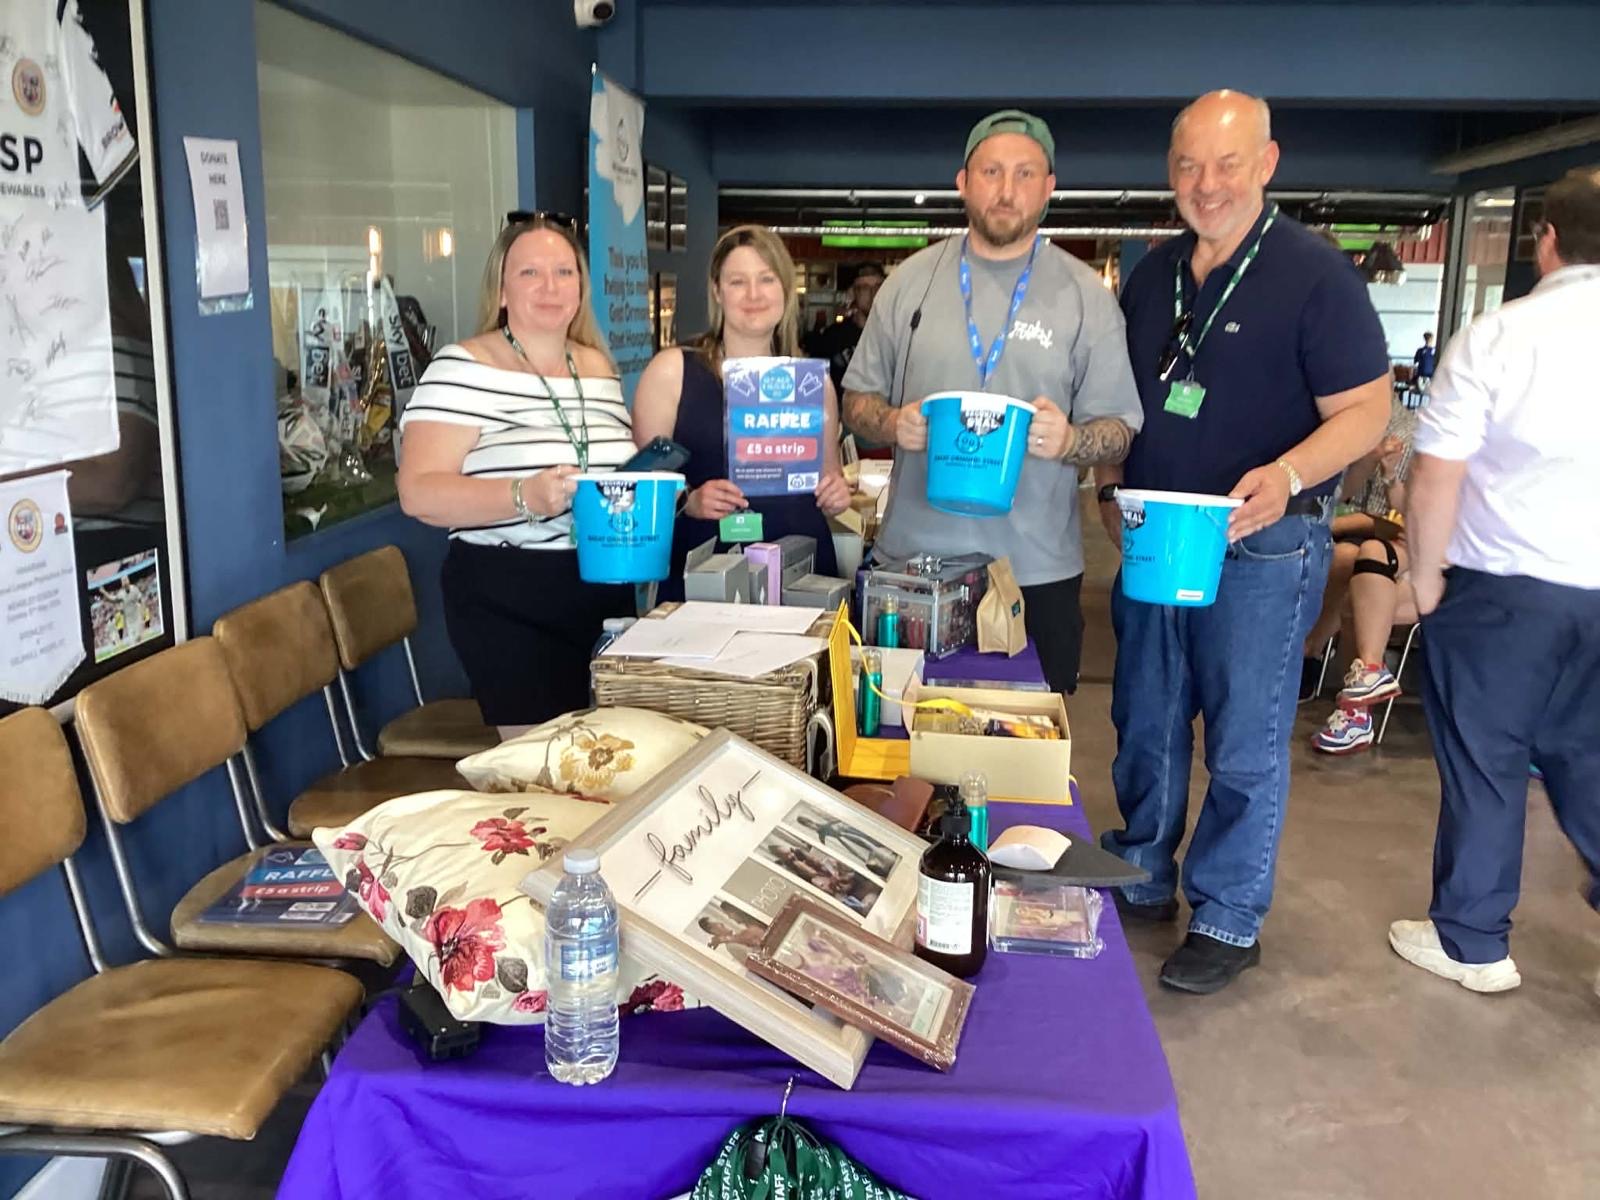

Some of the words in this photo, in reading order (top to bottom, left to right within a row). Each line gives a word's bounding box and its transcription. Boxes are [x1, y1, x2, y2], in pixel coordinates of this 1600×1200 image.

[0, 133, 43, 173] SP
[396, 354, 413, 386] bet
[764, 445, 774, 454] a
[775, 442, 806, 457] strip
[647, 784, 755, 882] family
[264, 868, 333, 881] RAFFL
[291, 886, 330, 895] strip
[717, 1131, 740, 1167] STAFF
[721, 1158, 732, 1200] STAFF
[774, 1174, 785, 1200] TAFF
[840, 1160, 853, 1199] STAFF
